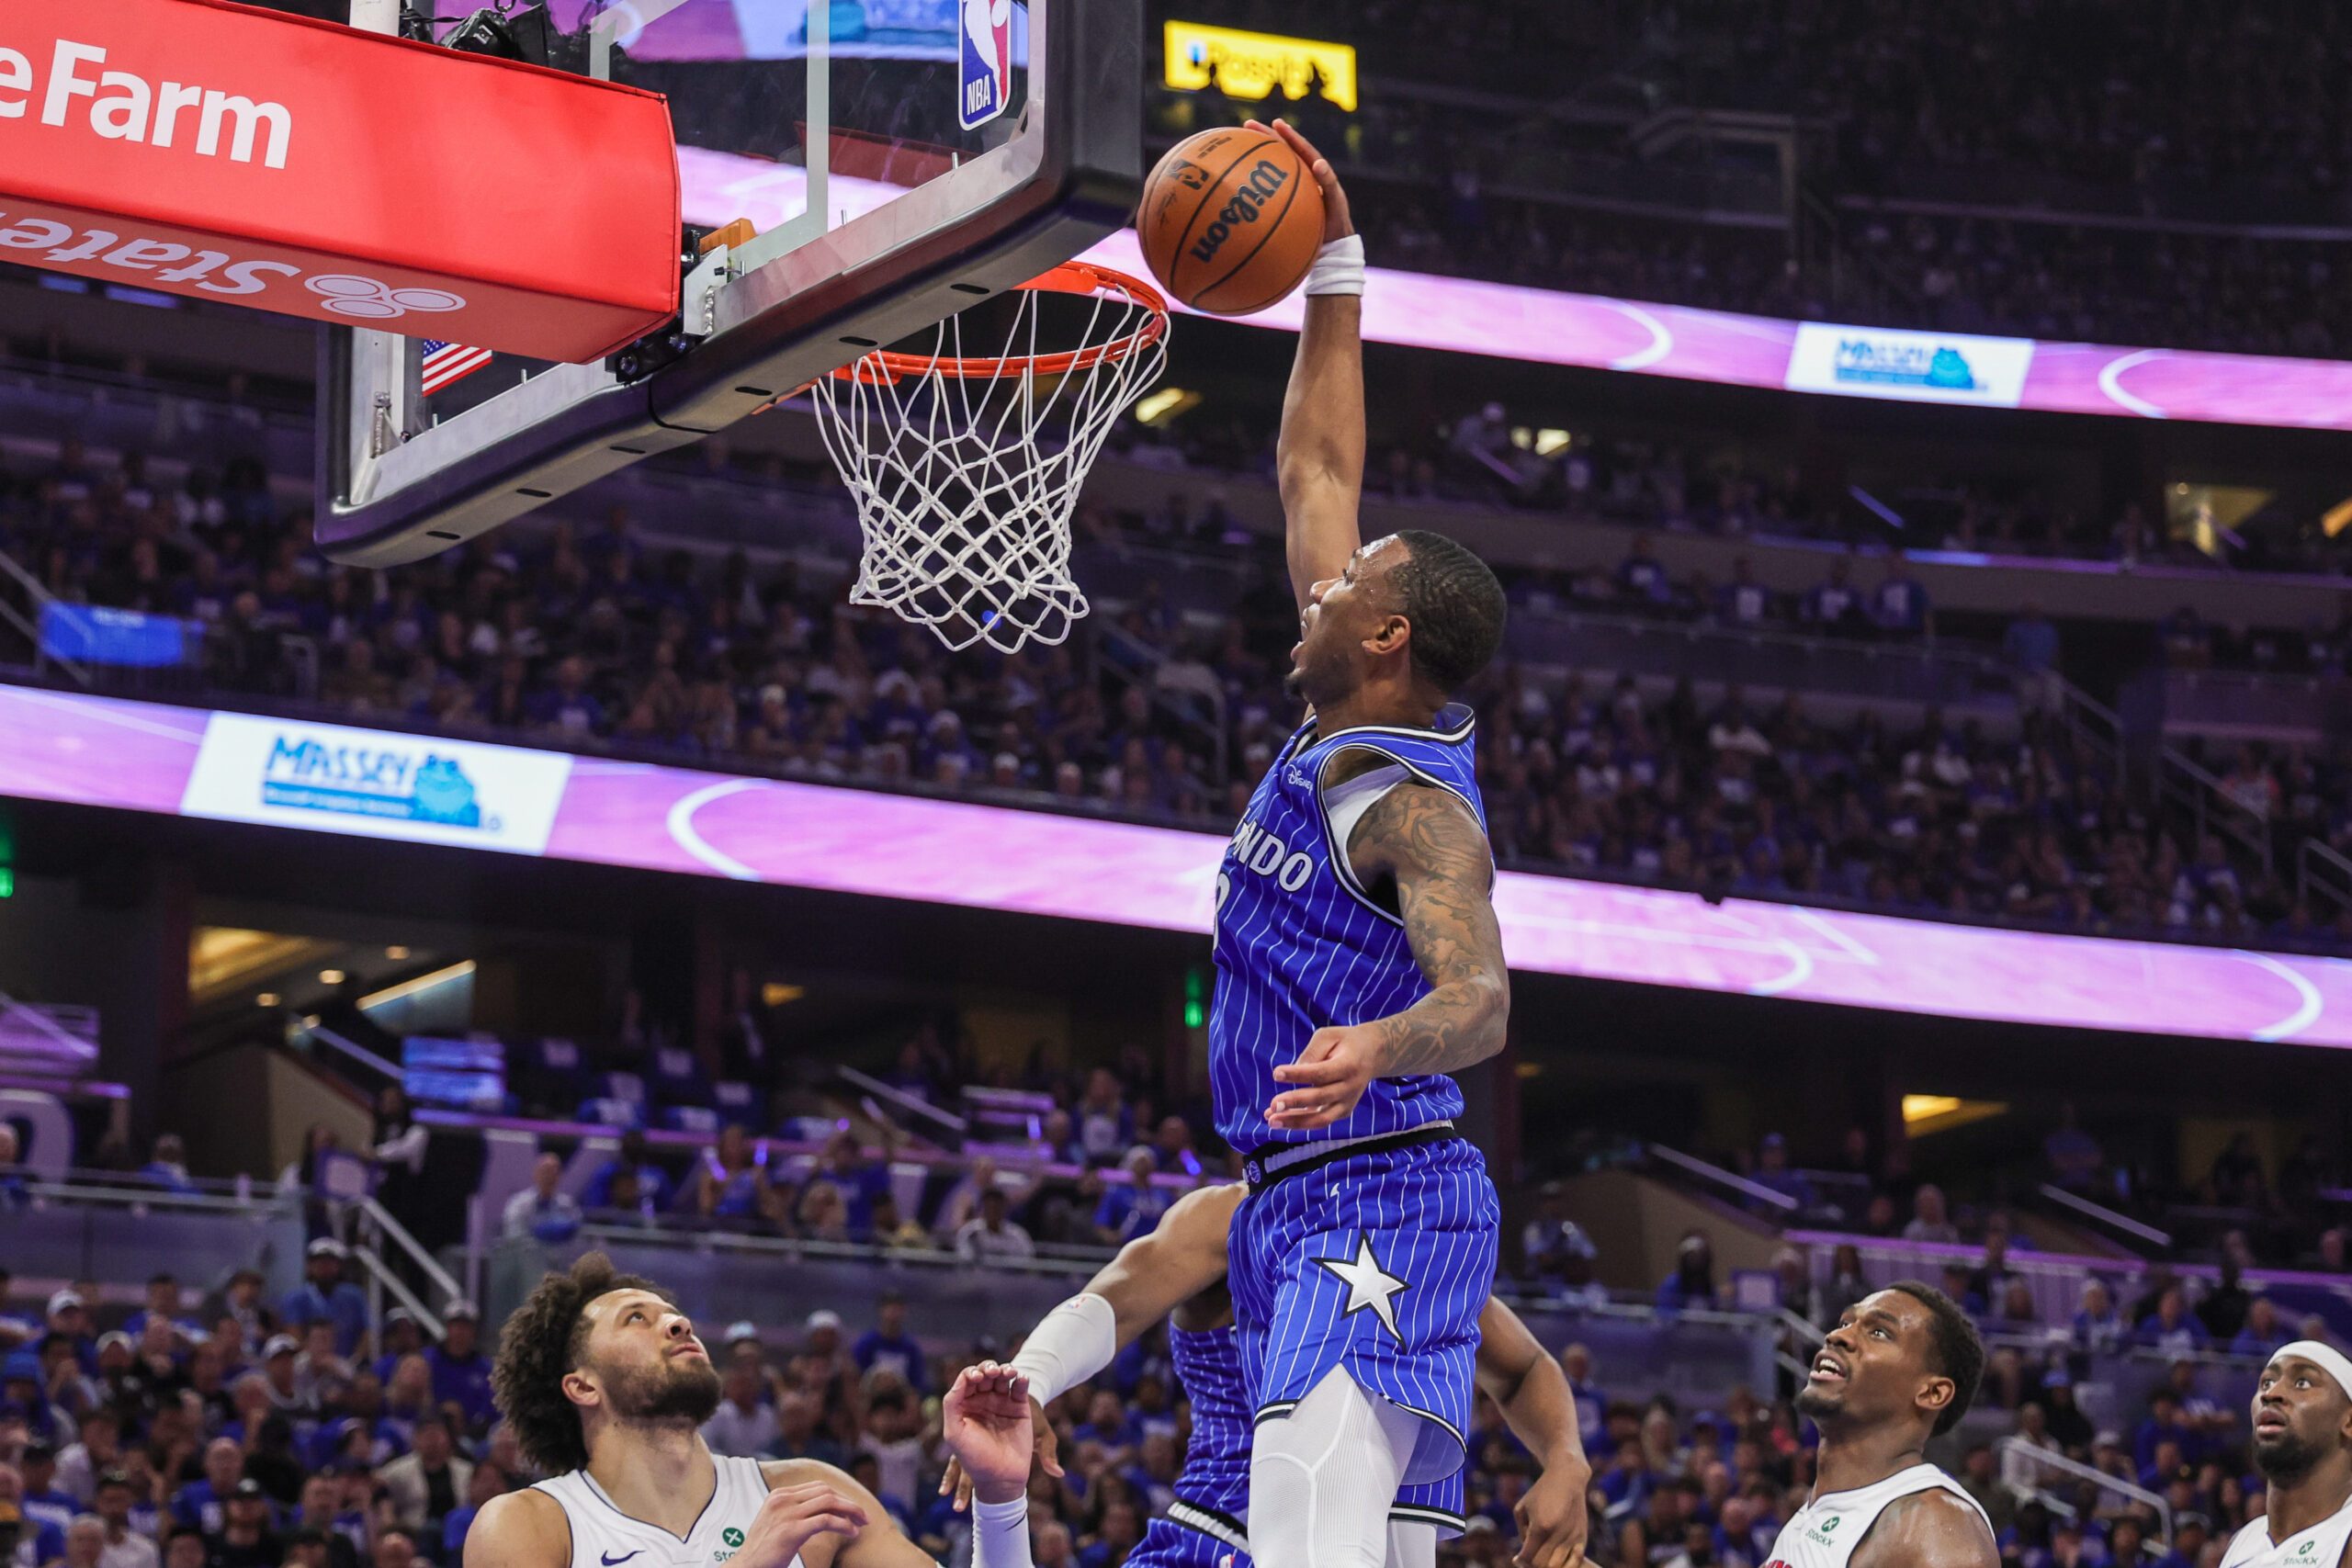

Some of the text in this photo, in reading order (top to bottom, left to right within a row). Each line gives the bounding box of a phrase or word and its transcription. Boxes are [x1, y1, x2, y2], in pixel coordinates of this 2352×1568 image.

[41, 39, 291, 169] Farm
[967, 74, 991, 116] NBA
[1191, 160, 1288, 264] Wilson
[0, 219, 302, 294] State
[1288, 763, 1314, 796] Disney
